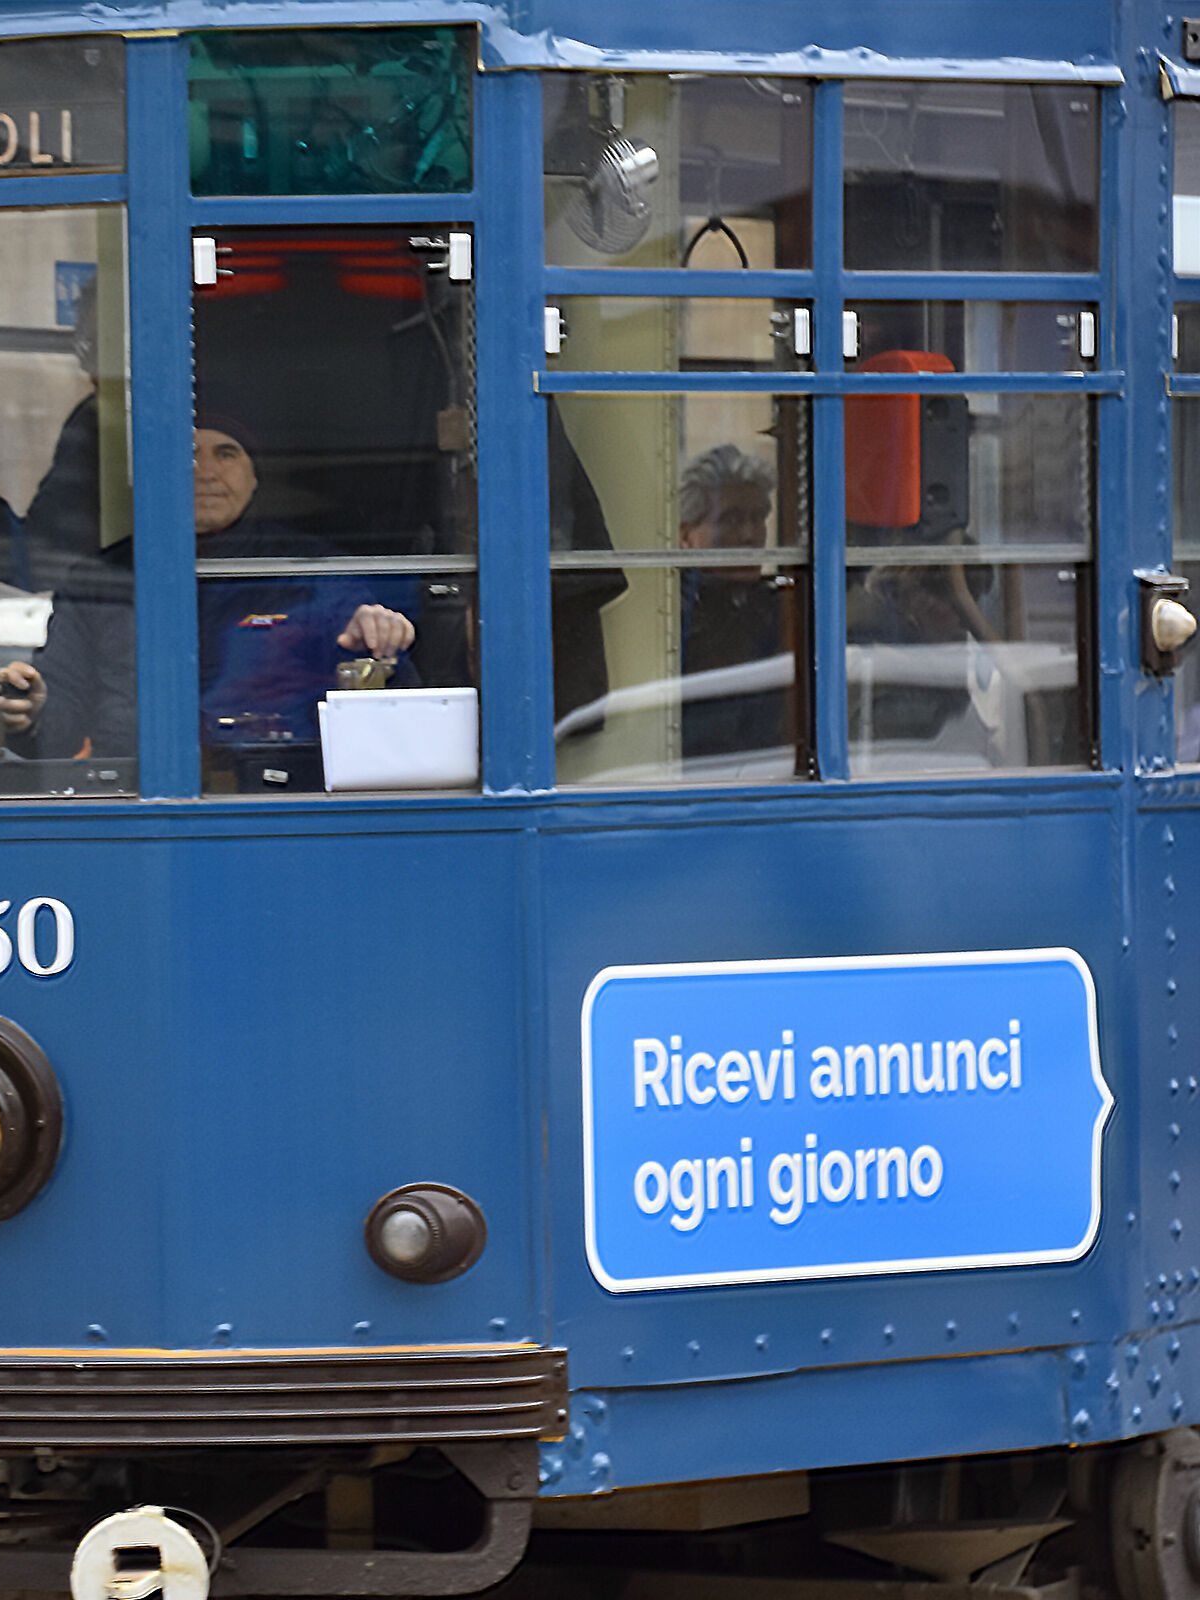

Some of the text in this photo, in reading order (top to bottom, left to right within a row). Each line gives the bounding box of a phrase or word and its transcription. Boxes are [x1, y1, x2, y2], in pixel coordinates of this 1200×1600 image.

[633, 1018, 1022, 1108] Ricevi annunci
[633, 1133, 944, 1232] ogni giorno
